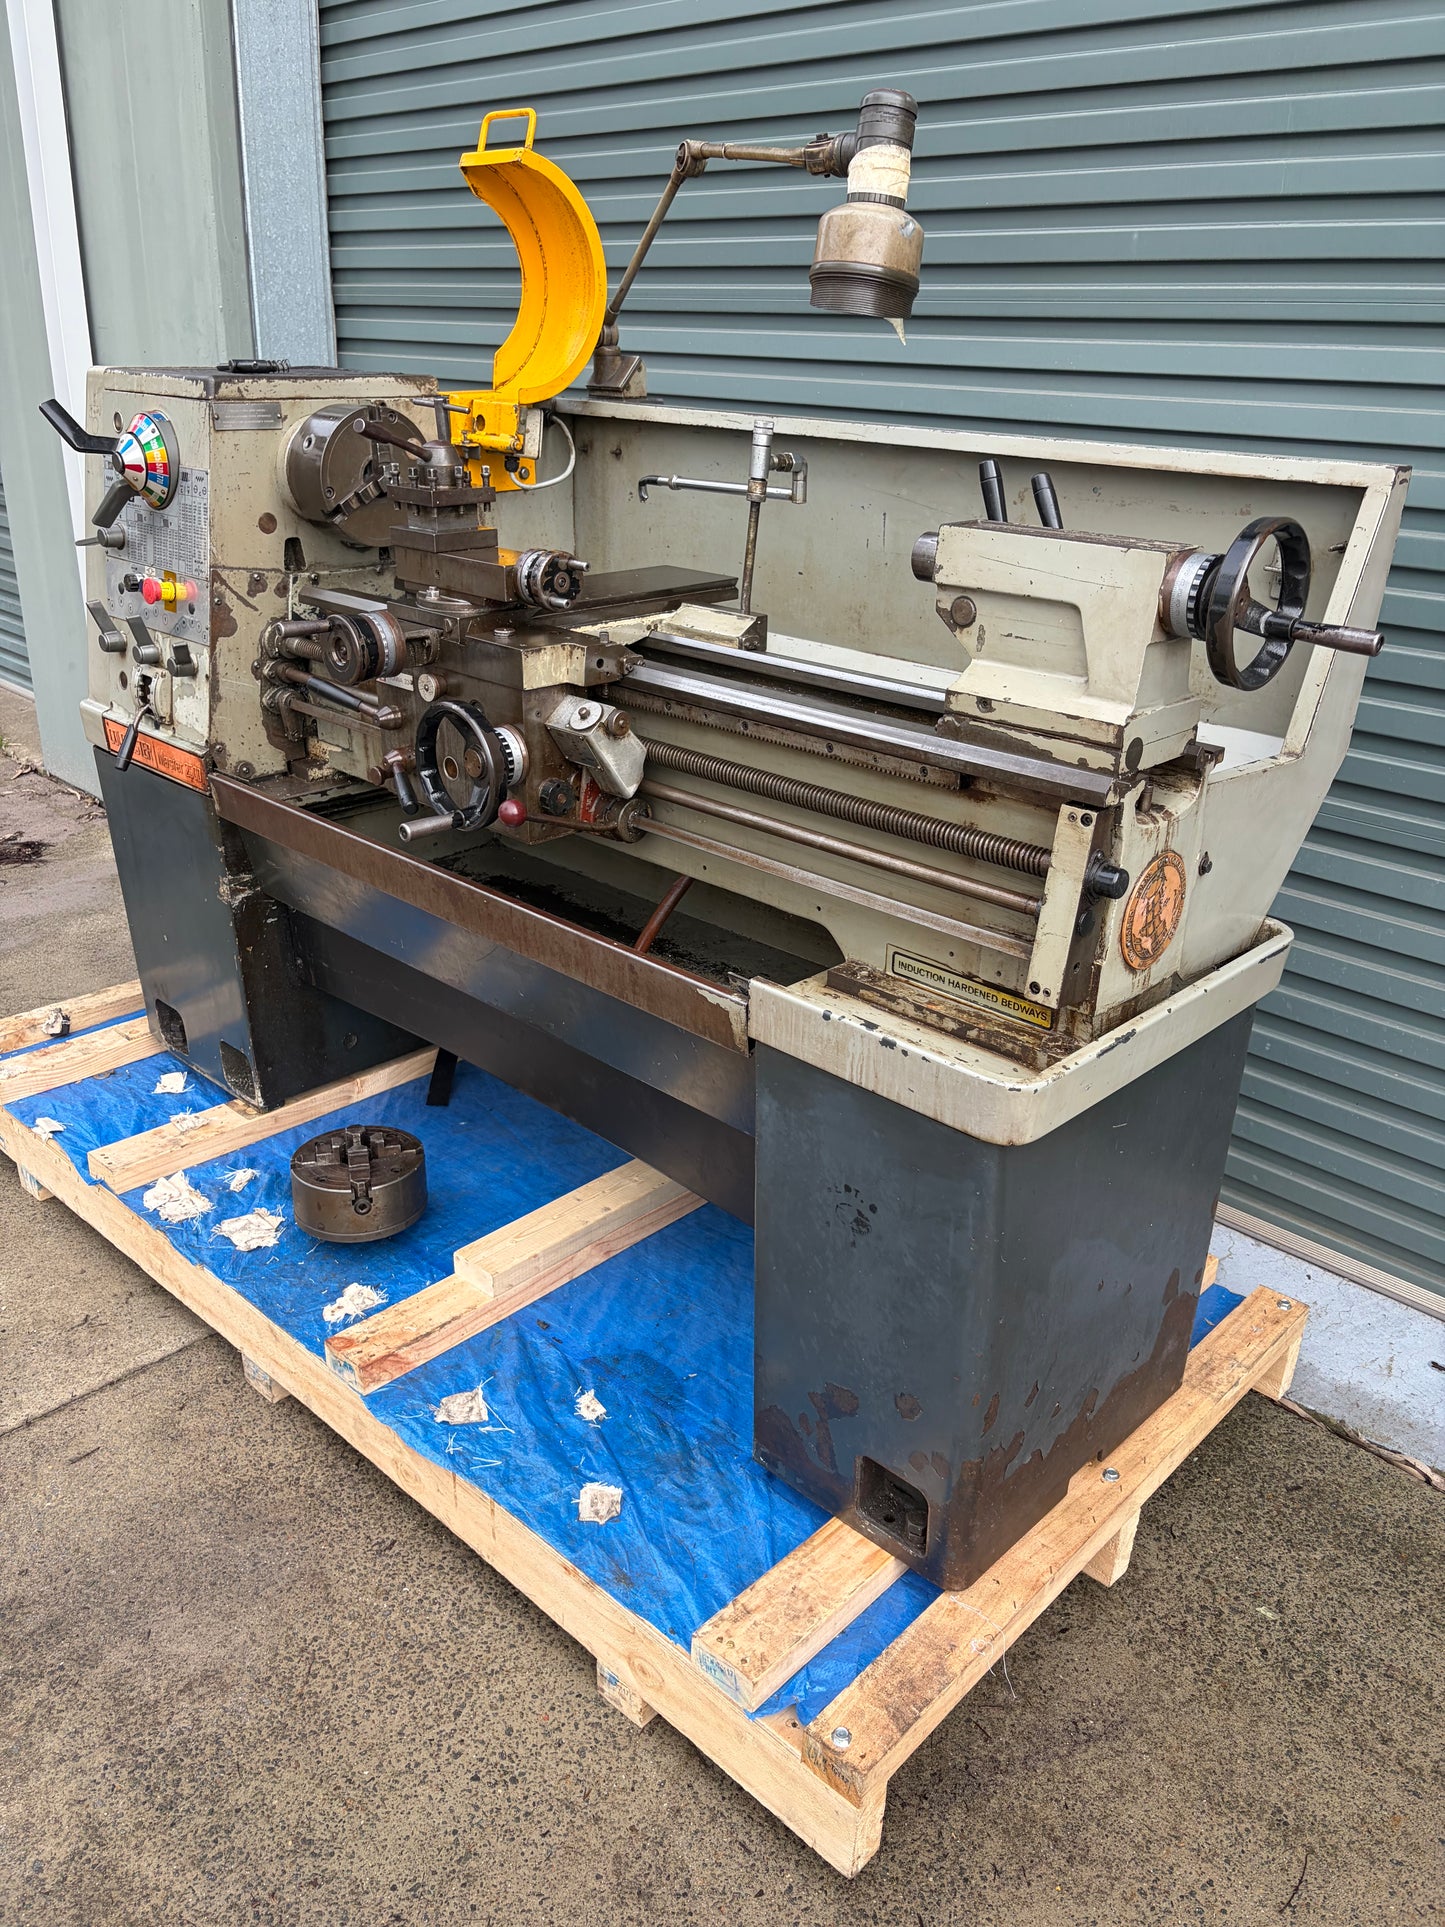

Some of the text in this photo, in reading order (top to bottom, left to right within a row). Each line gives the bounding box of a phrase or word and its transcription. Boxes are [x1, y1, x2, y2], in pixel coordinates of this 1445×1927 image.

[156, 462, 164, 474] 570
[156, 474, 164, 485] 770
[898, 960, 1049, 1022] INDUCTION HARDENED BEDWAYS.
